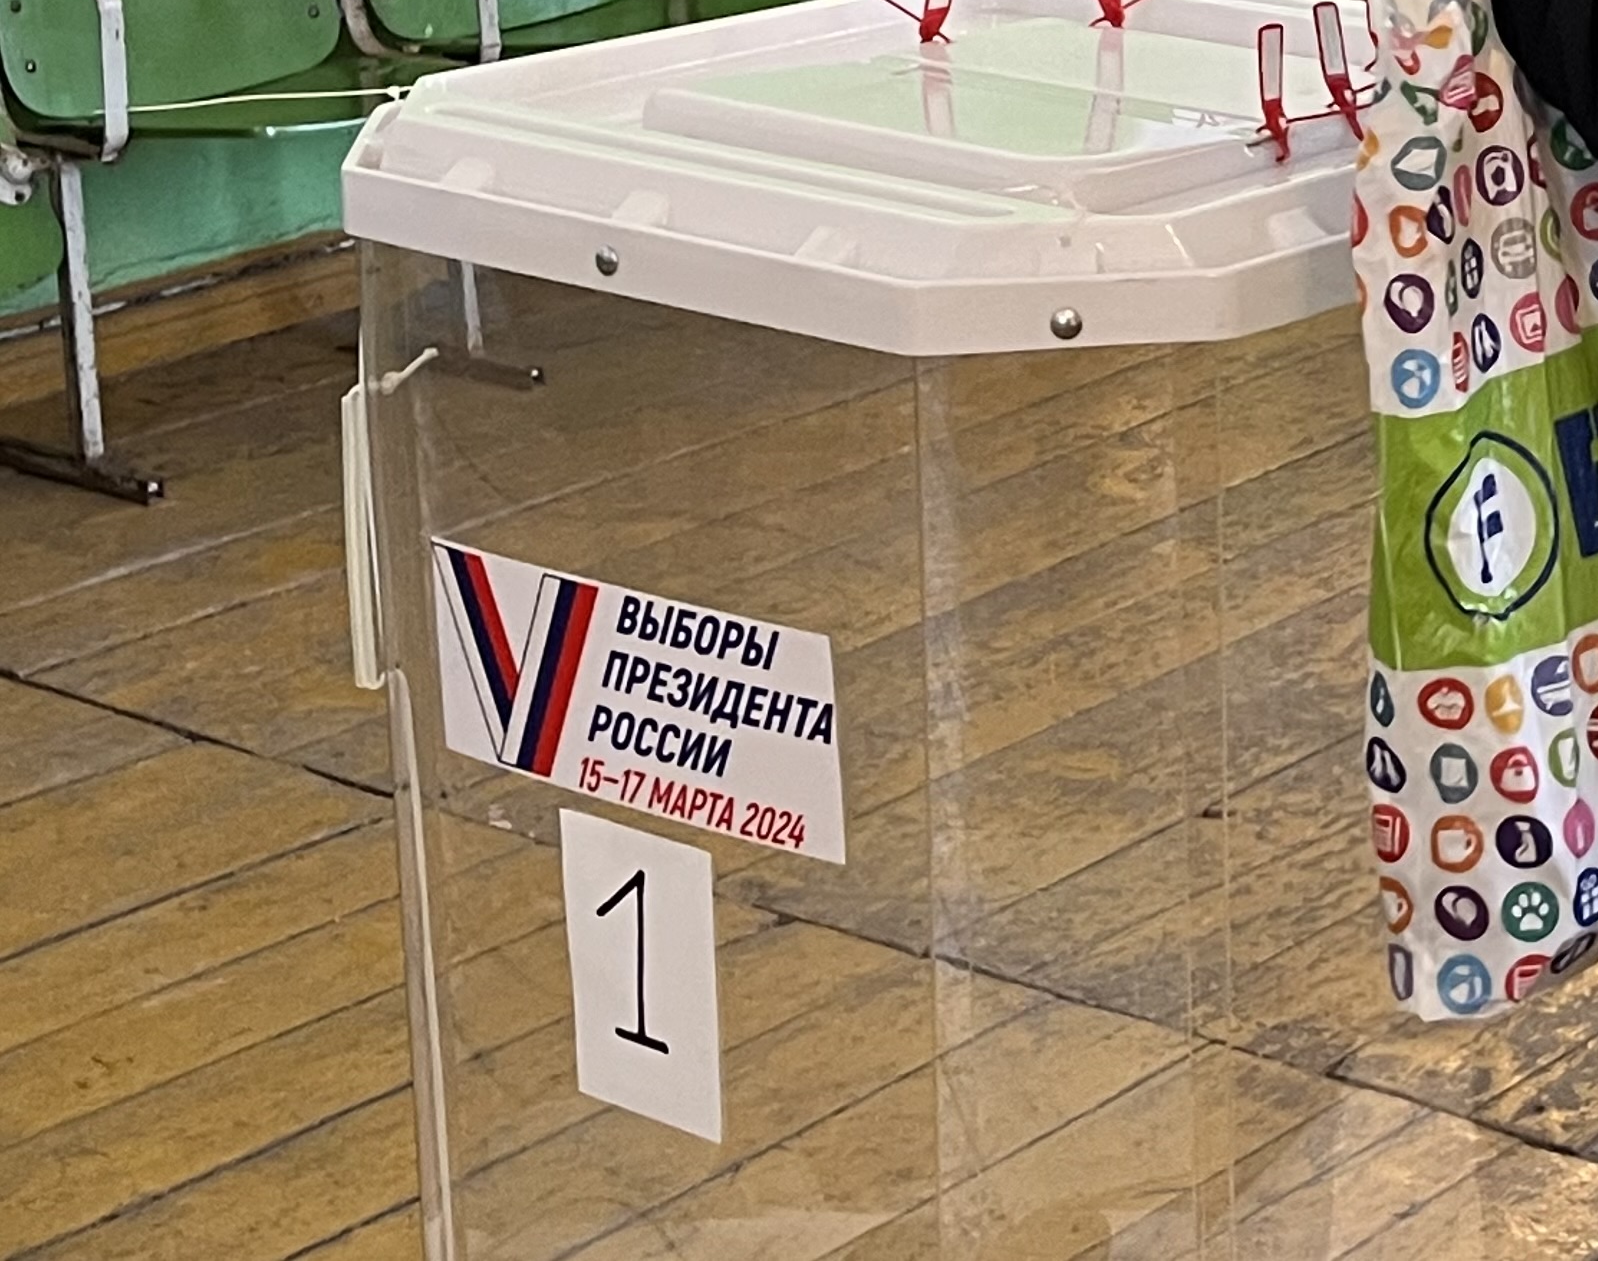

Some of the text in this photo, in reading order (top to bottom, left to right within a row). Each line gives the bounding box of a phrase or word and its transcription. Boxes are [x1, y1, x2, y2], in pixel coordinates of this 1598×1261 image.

[615, 594, 780, 671] ВЫБОРЫ
[601, 649, 835, 745] ПРЕЗИДЕНТА
[587, 704, 733, 778] РОССИИ
[648, 783, 733, 832] МАРТА
[740, 802, 806, 850] 2024
[595, 869, 669, 1055] 1
